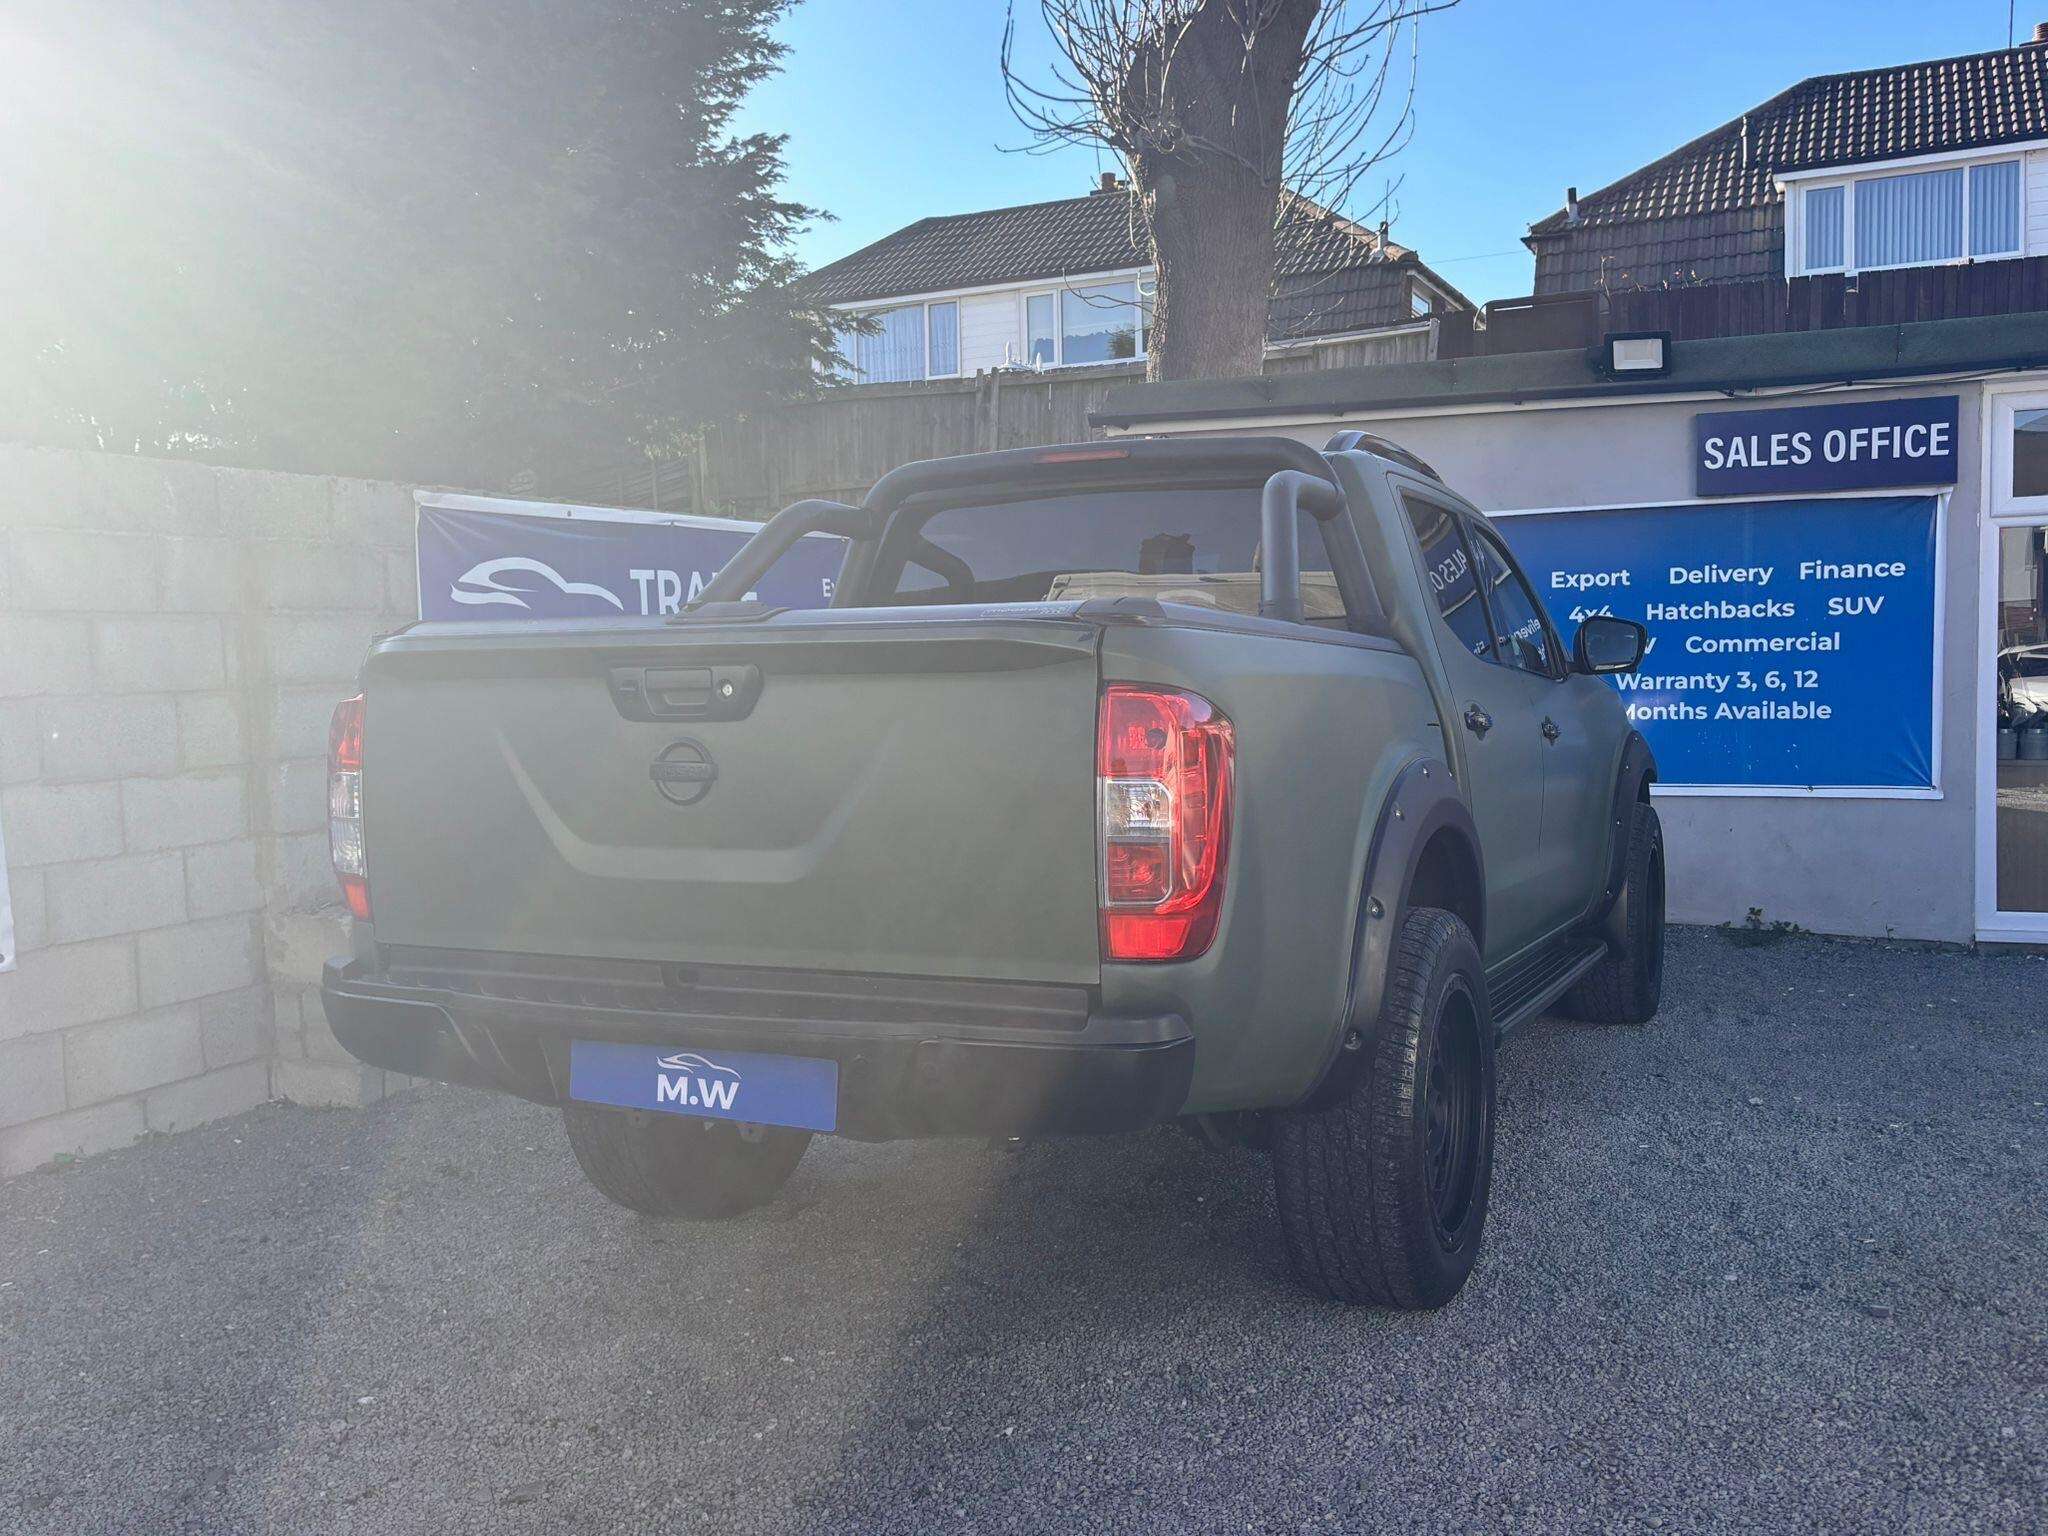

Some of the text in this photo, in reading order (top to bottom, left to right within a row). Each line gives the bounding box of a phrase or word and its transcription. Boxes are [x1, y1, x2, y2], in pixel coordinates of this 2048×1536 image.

[1704, 422, 1950, 470] SALES OFFICE
[1551, 560, 1907, 592] Export Delivery Finance
[1569, 596, 1885, 623] 4x4 Hatchbacks SUV
[1685, 632, 1840, 654] Commercial
[1615, 670, 1819, 694] Warranty 3, 6, 12
[1714, 701, 1832, 720] Available
[656, 1073, 740, 1110] M.W
